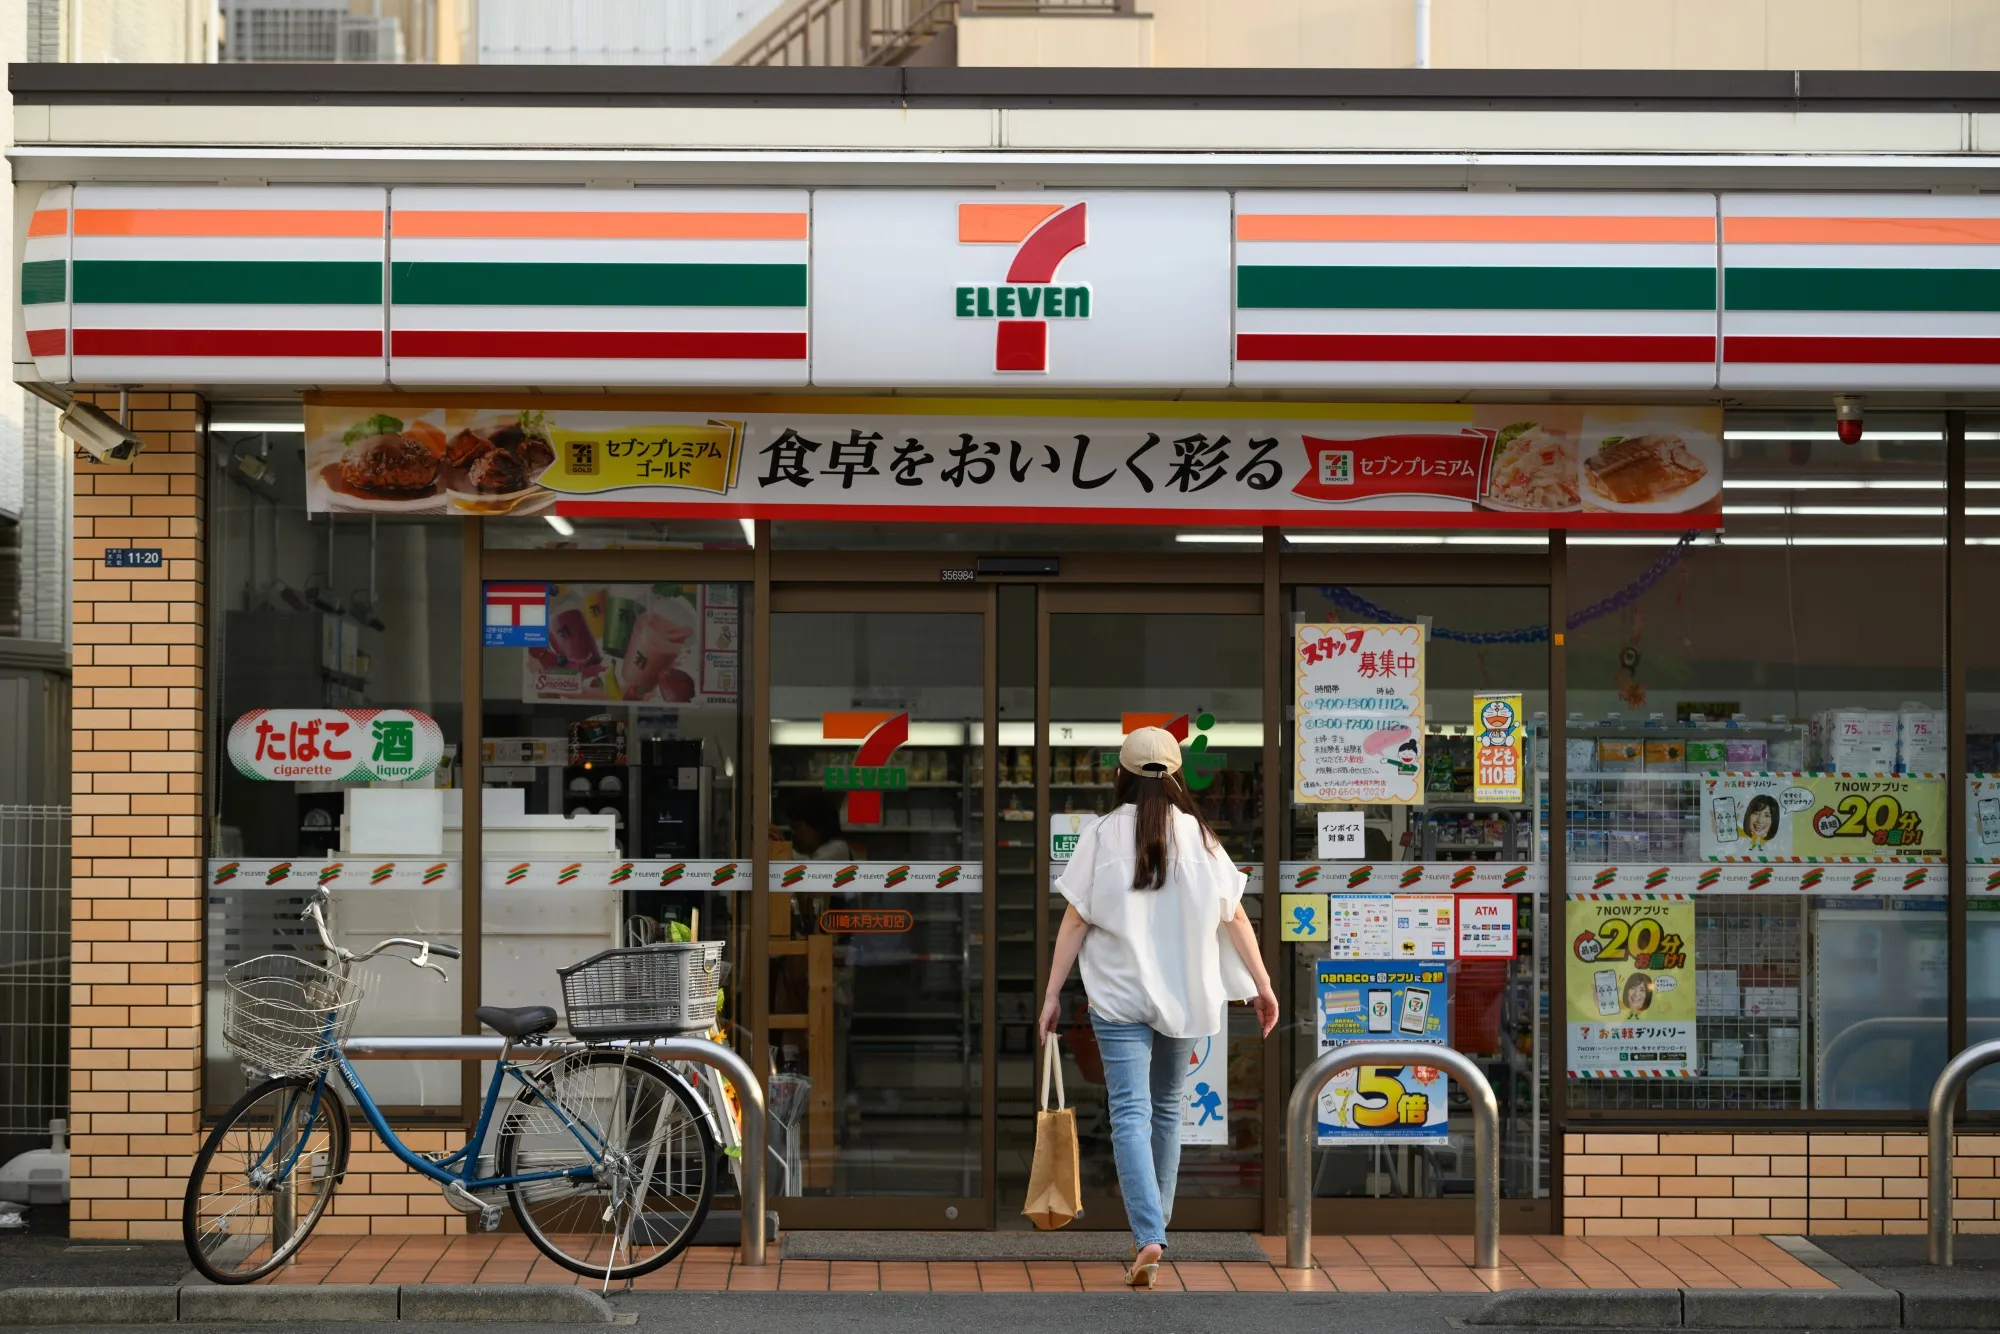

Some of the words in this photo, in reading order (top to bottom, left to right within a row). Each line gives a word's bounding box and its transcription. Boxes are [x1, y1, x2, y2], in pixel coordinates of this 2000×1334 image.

[606, 439, 722, 459] セブンプレミアム
[757, 428, 1283, 493] 食卓をおいしく彩る
[636, 461, 691, 479] ゴールド
[1360, 457, 1475, 477] セブンプレミアム
[128, 553, 159, 564] 11-20
[942, 570, 974, 580] 356984
[1301, 630, 1365, 666] スタッフ
[1357, 649, 1416, 679] 募集中
[1376, 687, 1395, 695] 時給
[255, 718, 352, 762] たばこ
[372, 720, 414, 762] 酒
[1480, 748, 1515, 766] こども
[274, 765, 332, 777] cigarette
[376, 765, 414, 776] liquor
[1480, 766, 1516, 784] 110番
[1723, 780, 1777, 788] お気軽デリバリー
[1834, 781, 1909, 793] 7NOWアプリで
[1322, 823, 1361, 832] インボイス
[1820, 820, 1839, 831] 最短
[1328, 834, 1356, 843] 対象店
[1475, 906, 1498, 916] ATM
[1596, 906, 1669, 916] 7NOWアプリで
[1581, 944, 1600, 956] 最短
[1598, 1026, 1686, 1039] お気軽デリバリー
